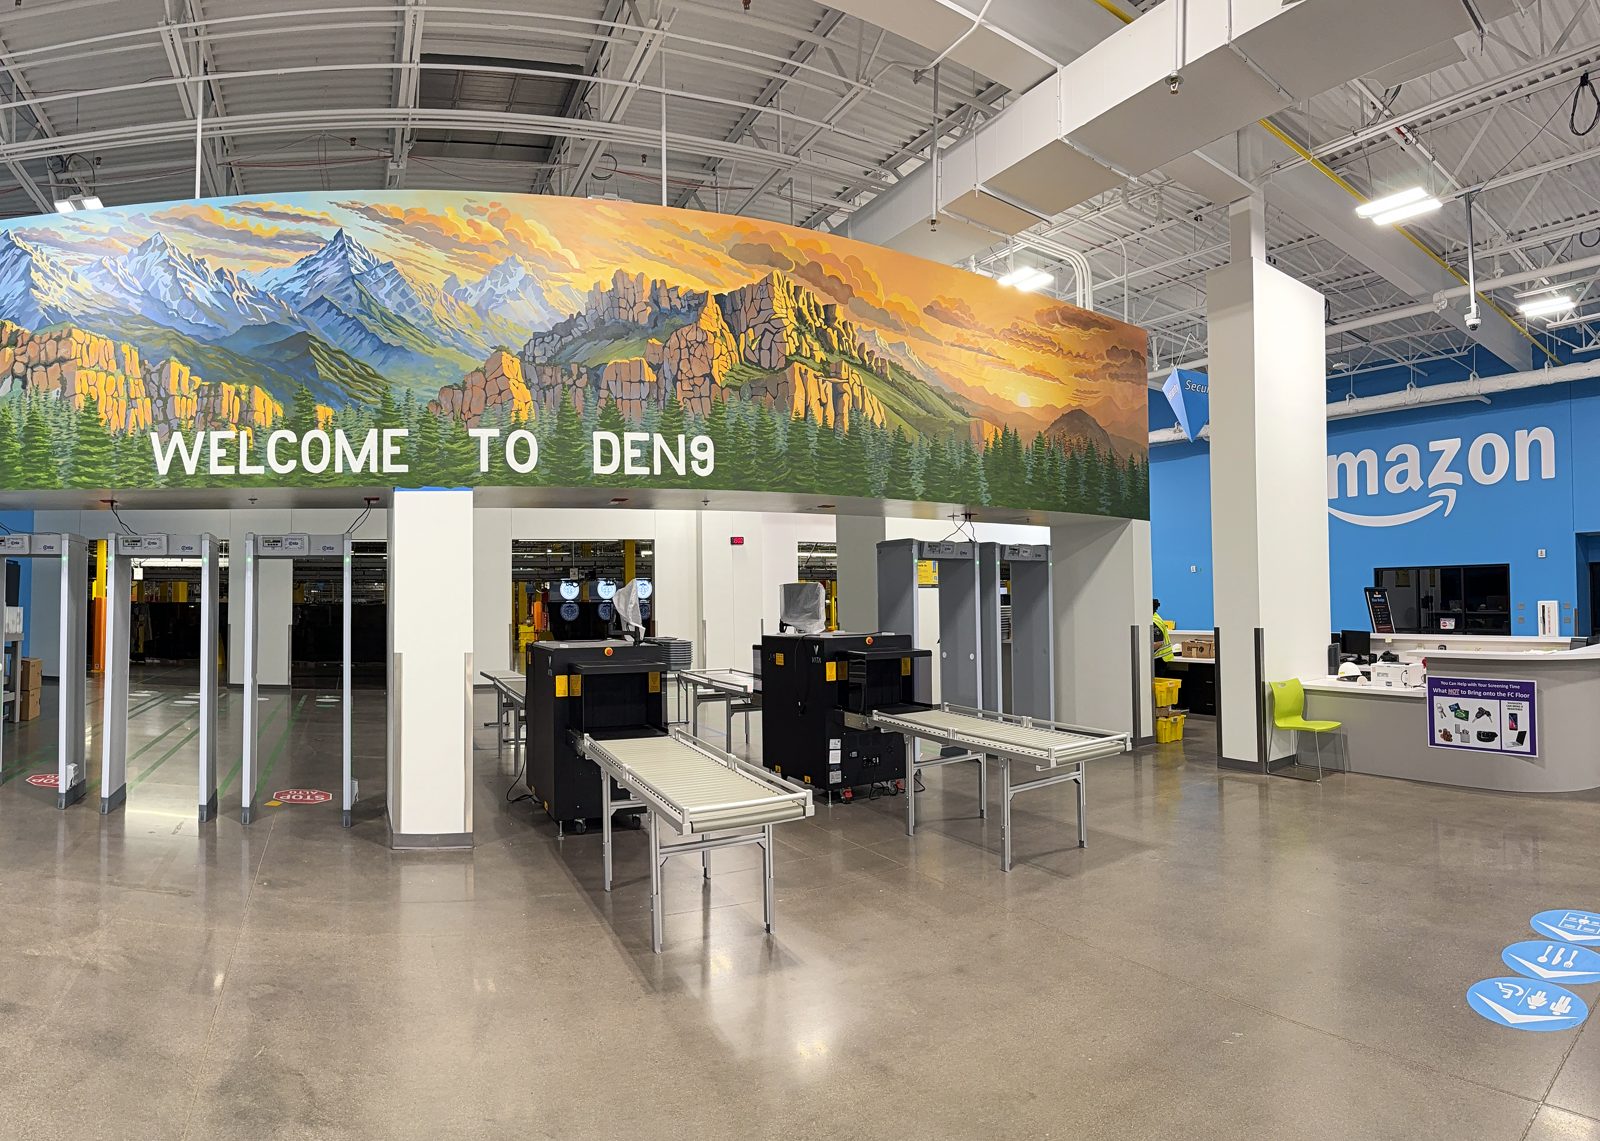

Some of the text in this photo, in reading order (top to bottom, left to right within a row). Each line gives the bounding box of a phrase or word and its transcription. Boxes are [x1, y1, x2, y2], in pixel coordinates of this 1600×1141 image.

[150, 427, 715, 477] WELCOME TO DEN9
